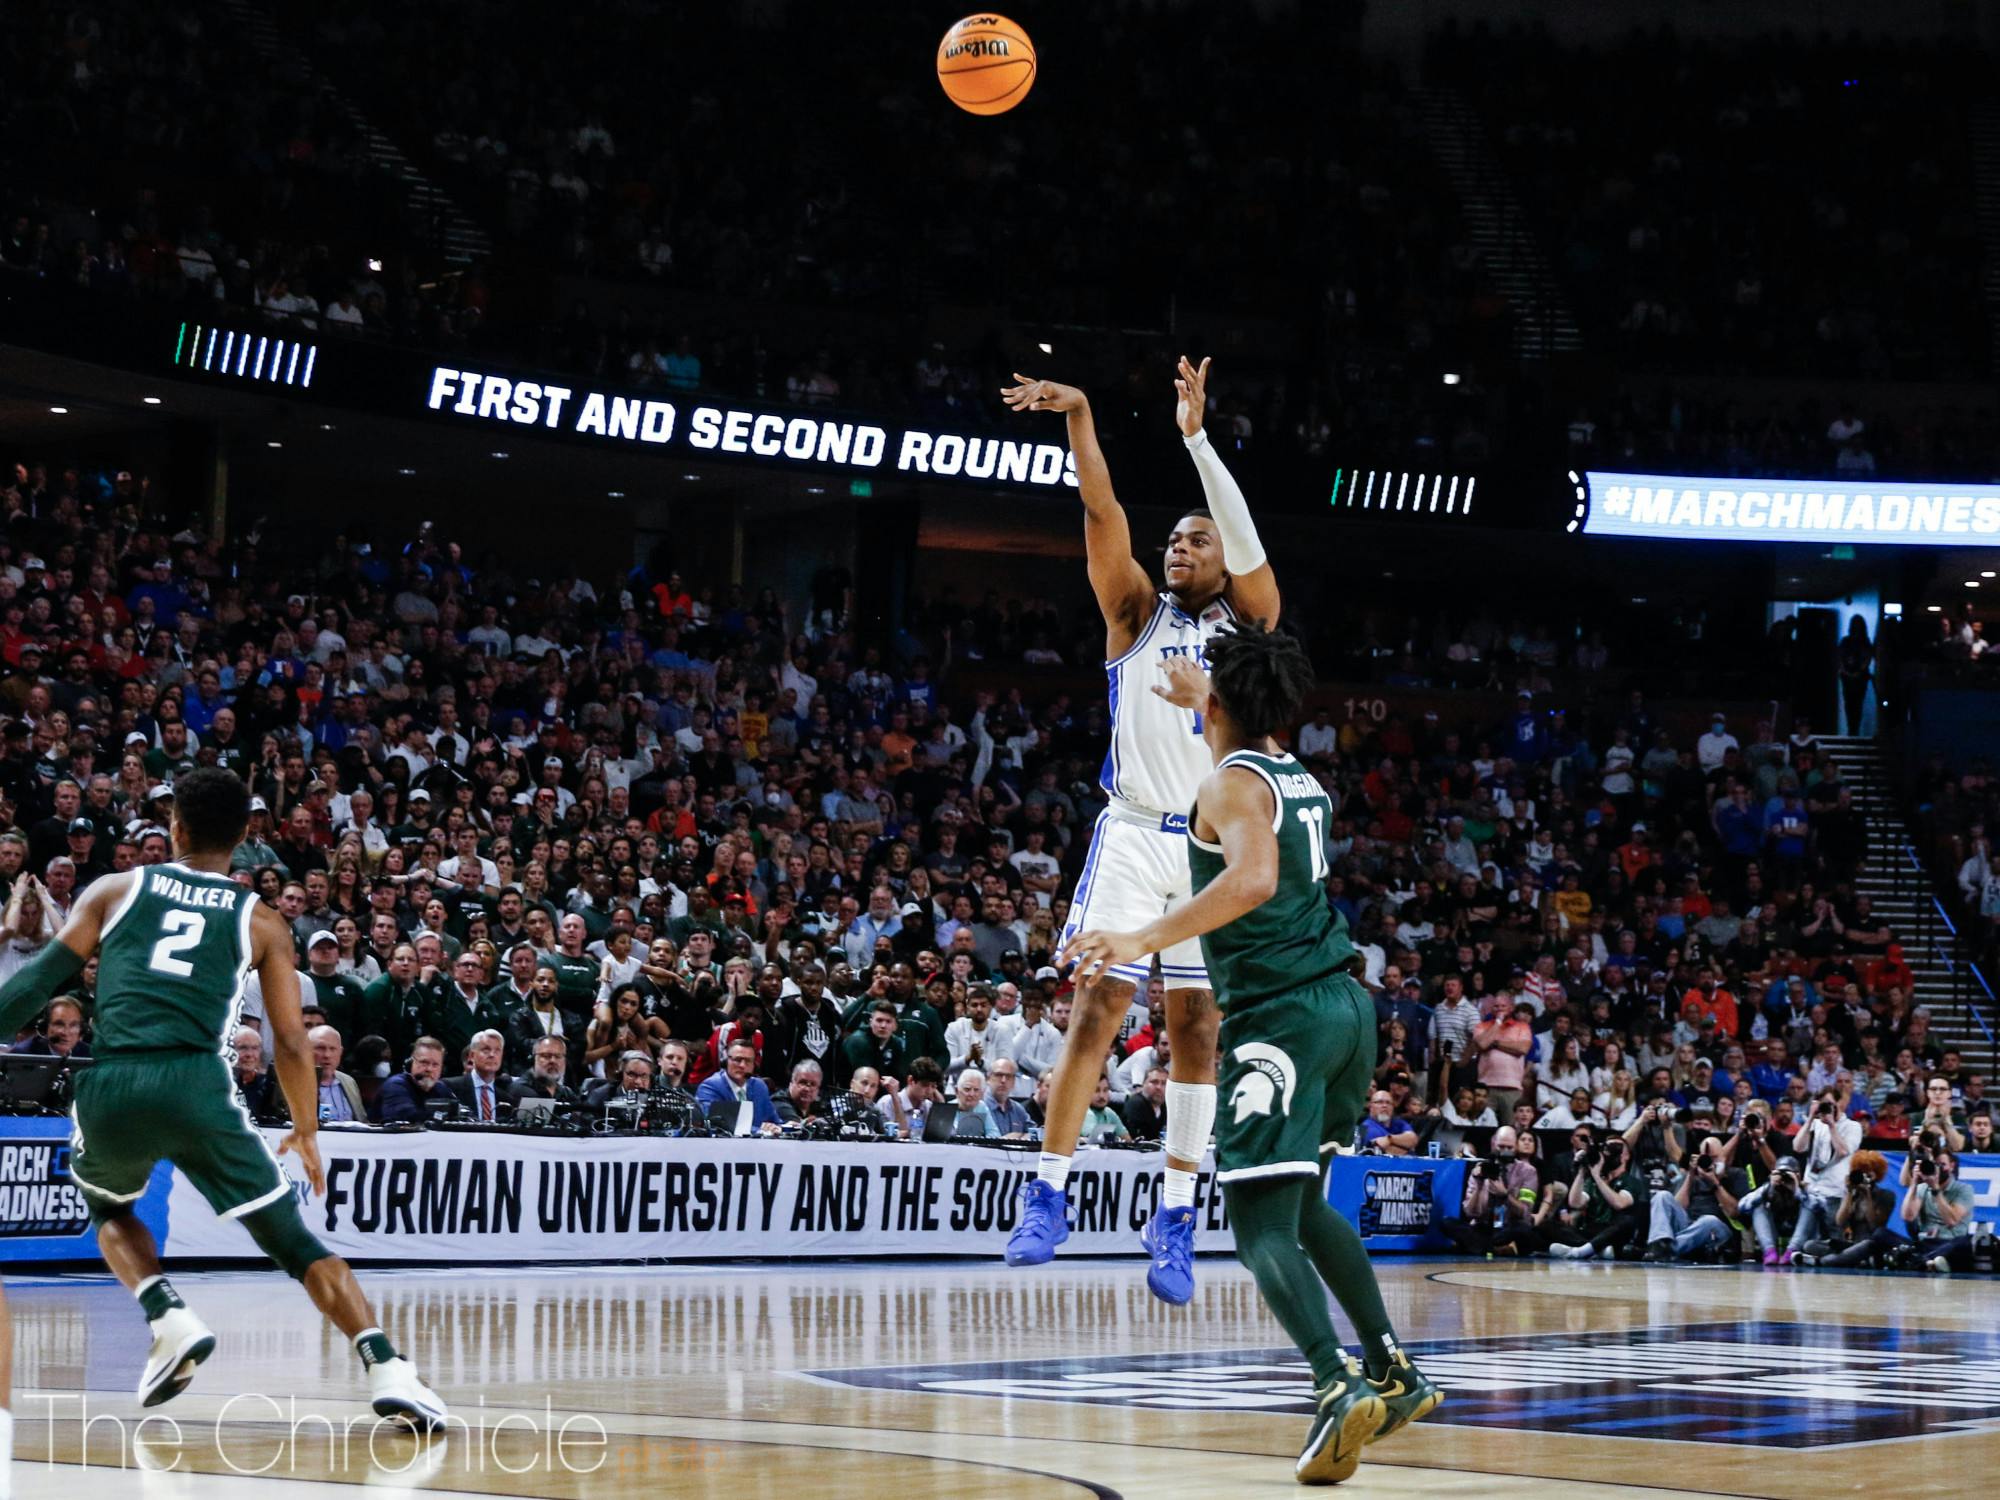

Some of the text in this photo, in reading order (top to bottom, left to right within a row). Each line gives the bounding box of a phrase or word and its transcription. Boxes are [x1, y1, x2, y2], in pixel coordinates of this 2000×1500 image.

[945, 38, 1010, 59] Wilson
[428, 367, 572, 429] FIRST
[576, 392, 676, 444] AND
[689, 407, 887, 468] SECOND
[1602, 484, 2000, 533] #MARCHMADNES
[1274, 772, 1326, 799] HOGGAR
[1296, 805, 1330, 883] 11
[151, 873, 237, 910] WALKER
[149, 908, 206, 977] 2
[0, 1146, 51, 1182] RCH
[0, 1185, 90, 1222] ADNESS
[325, 1158, 524, 1234] FURMAN
[538, 1161, 784, 1234] UNIVERSITY
[790, 1164, 870, 1232] AND
[880, 1165, 944, 1232] THE
[950, 1166, 1122, 1232] SOUERN
[1379, 1202, 1433, 1225] MADNESS
